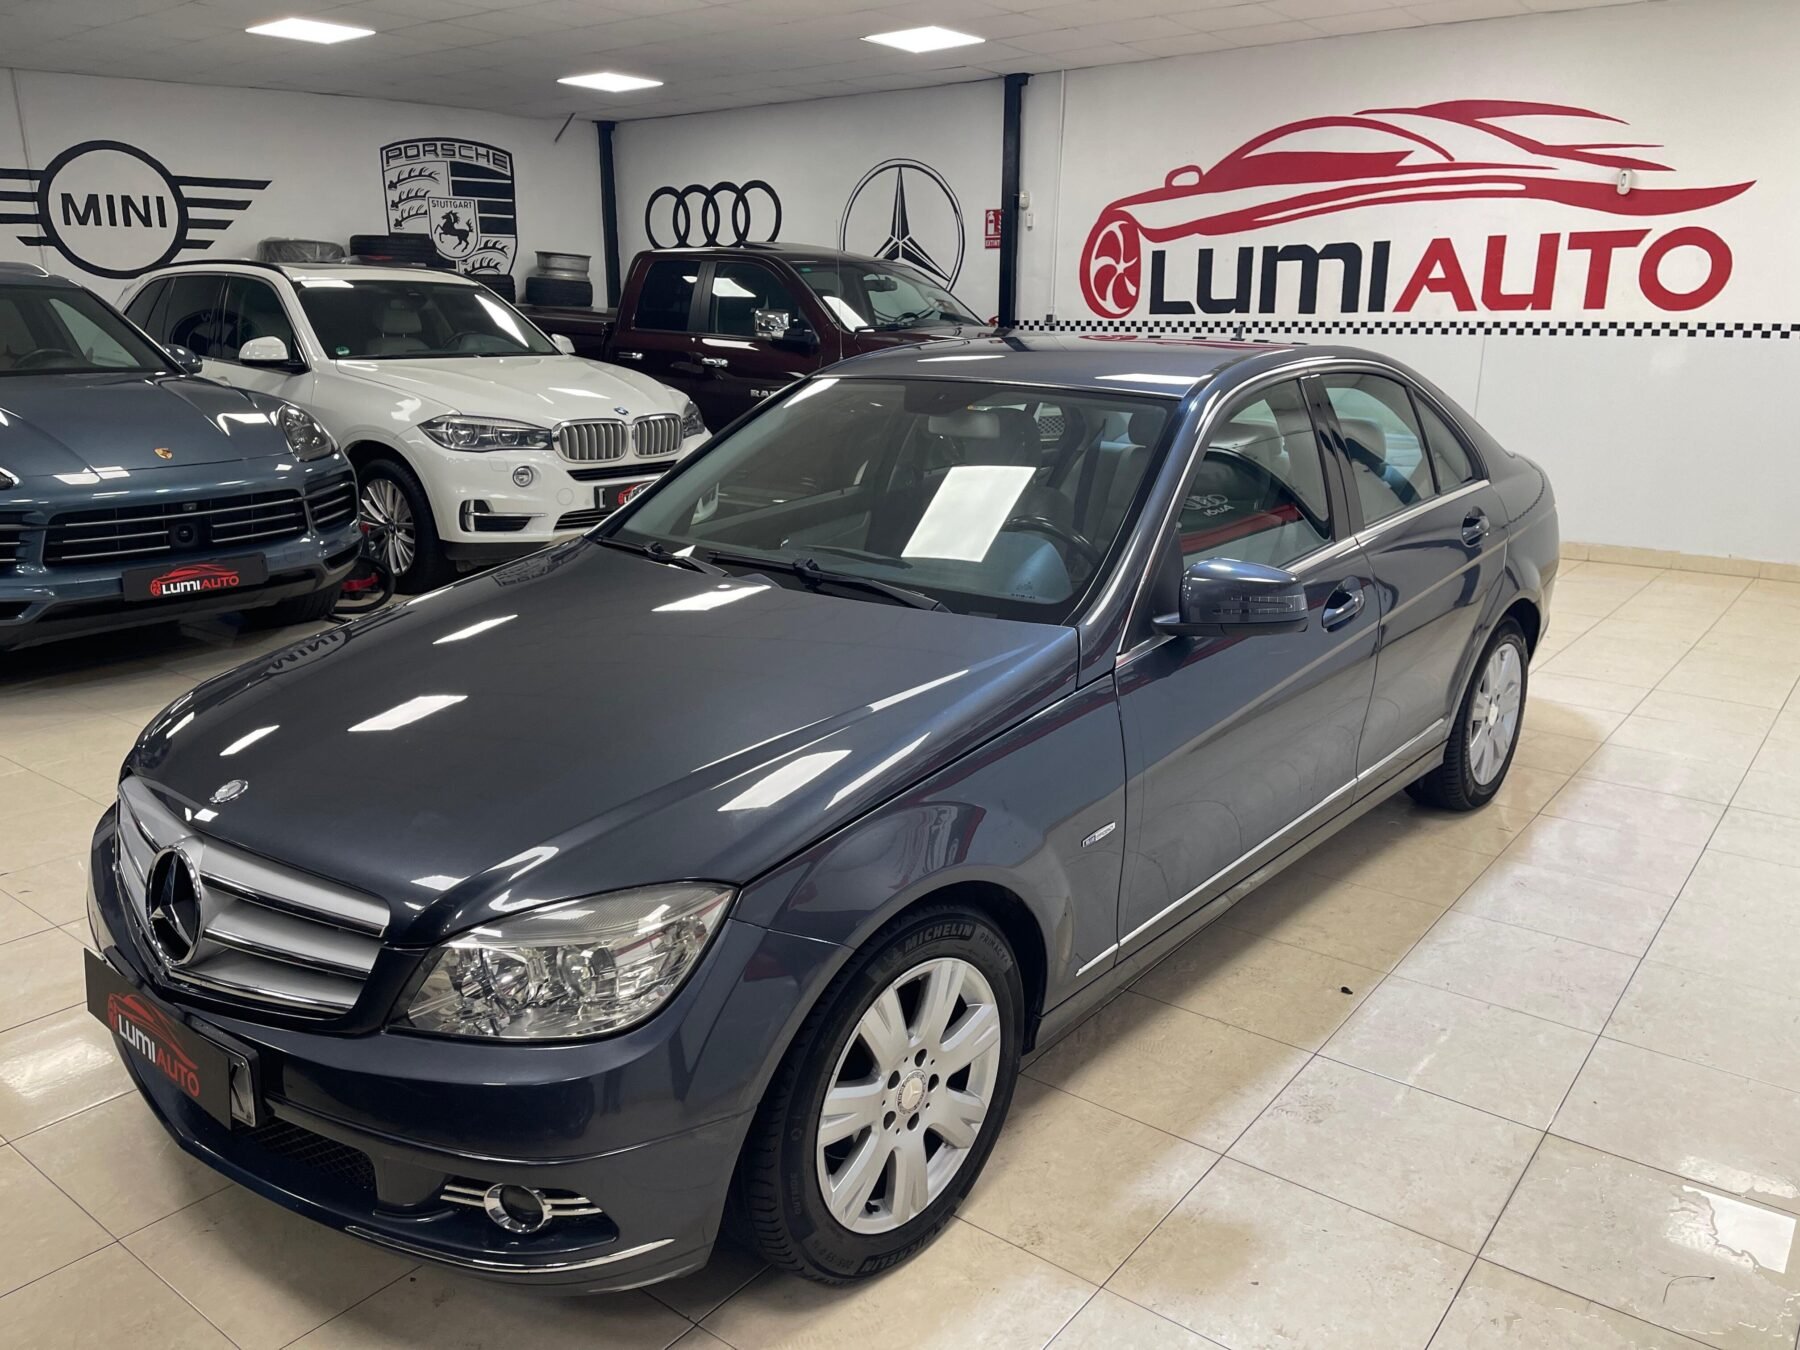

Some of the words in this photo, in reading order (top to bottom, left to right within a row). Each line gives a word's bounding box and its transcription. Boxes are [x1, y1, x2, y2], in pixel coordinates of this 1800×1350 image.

[385, 143, 509, 172] PORSCHE
[61, 193, 167, 227] MINI
[431, 200, 472, 209] STUTTGART
[905, 923, 973, 952] MICHELIN
